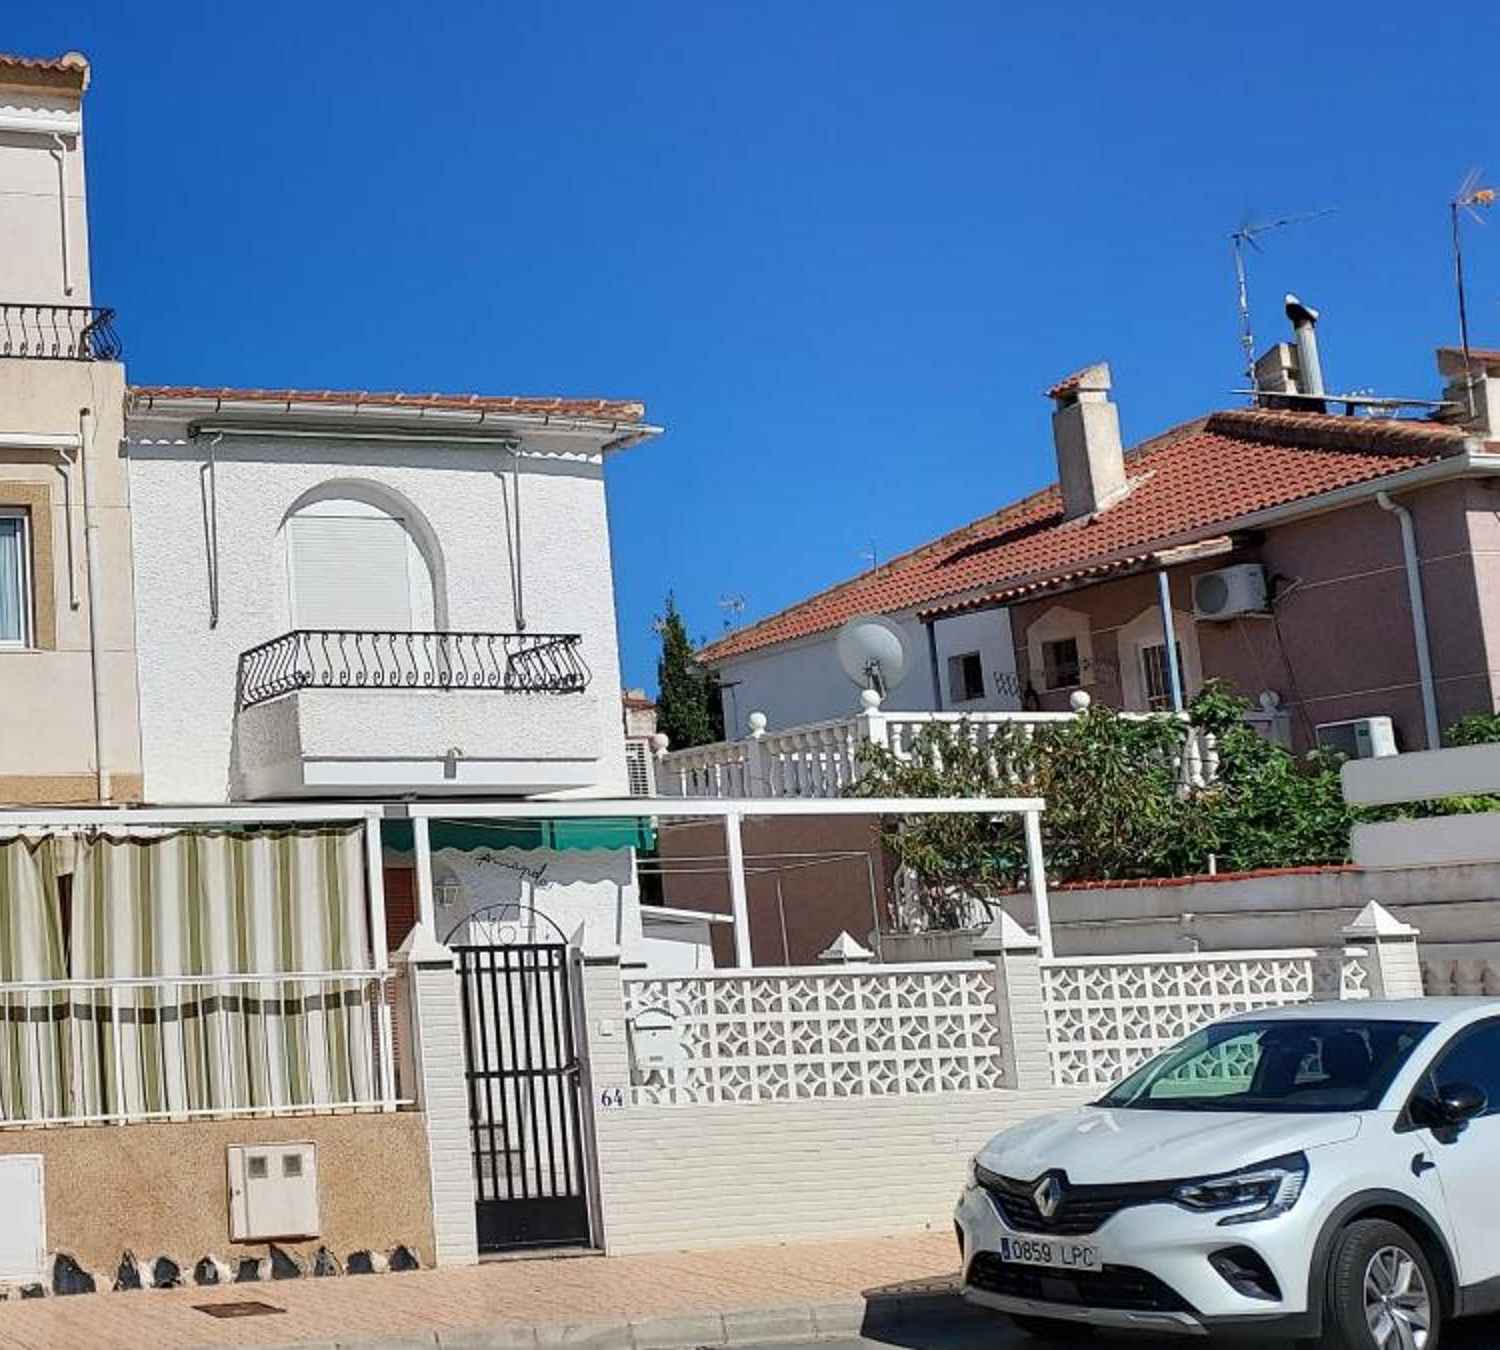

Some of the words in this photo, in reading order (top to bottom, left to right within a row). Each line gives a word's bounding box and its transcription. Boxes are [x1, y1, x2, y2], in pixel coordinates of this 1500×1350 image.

[601, 1088, 623, 1107] 64
[1012, 1240, 1052, 1262] 0859
[1061, 1246, 1093, 1267] LPC
